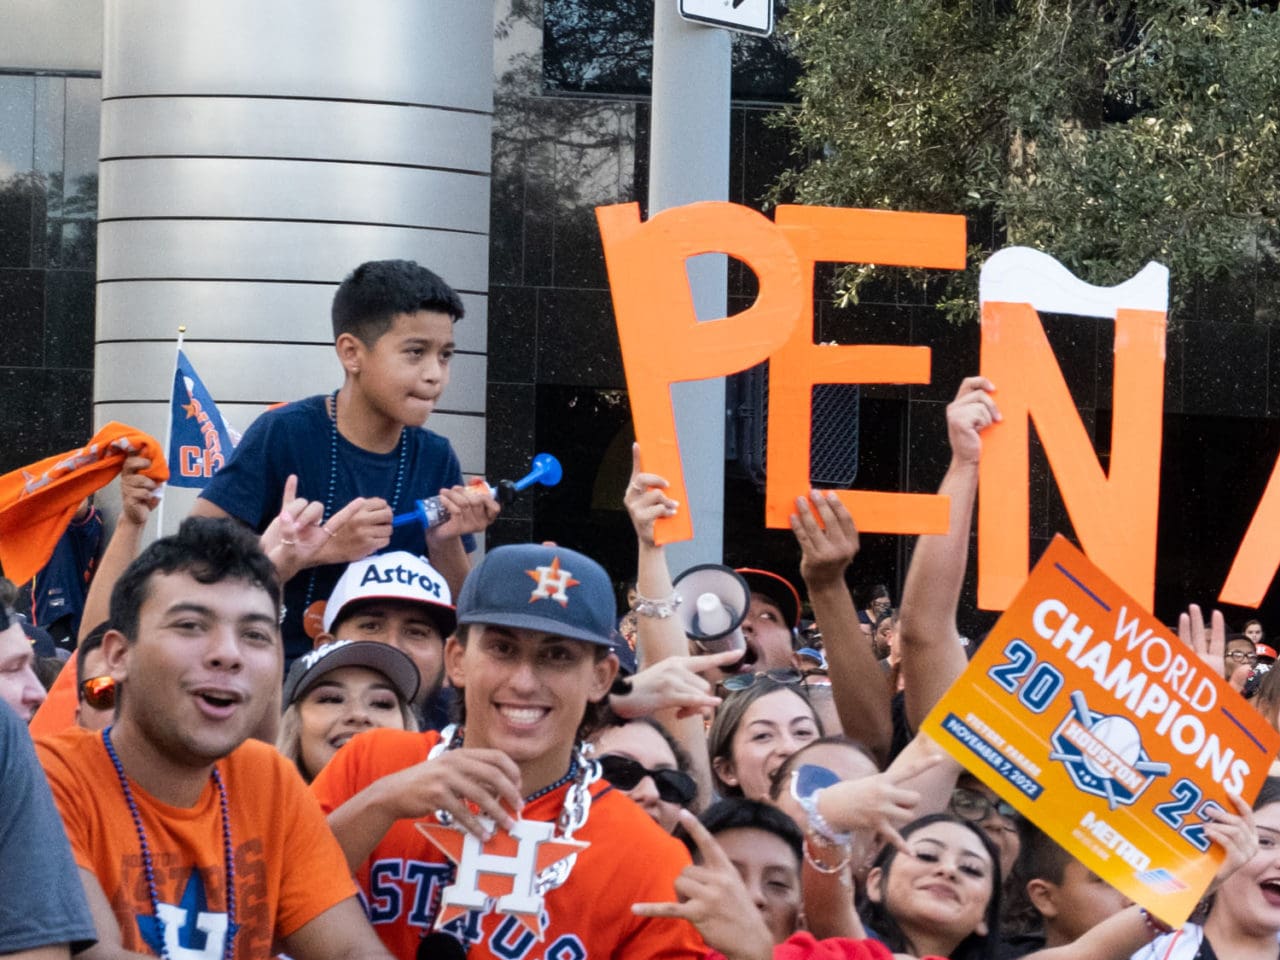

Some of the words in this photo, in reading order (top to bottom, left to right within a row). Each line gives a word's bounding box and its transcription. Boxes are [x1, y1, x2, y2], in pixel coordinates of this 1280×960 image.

[360, 564, 441, 599] Astros
[531, 566, 572, 601] H
[987, 639, 1065, 714] 20
[1113, 606, 1217, 712] WORLD
[1032, 599, 1250, 795] CHAMPIONS
[946, 718, 1004, 768] NOVEMBER
[1009, 770, 1039, 795] 2022
[1065, 720, 1143, 790] HOUSTON
[1080, 811, 1151, 873] METRO
